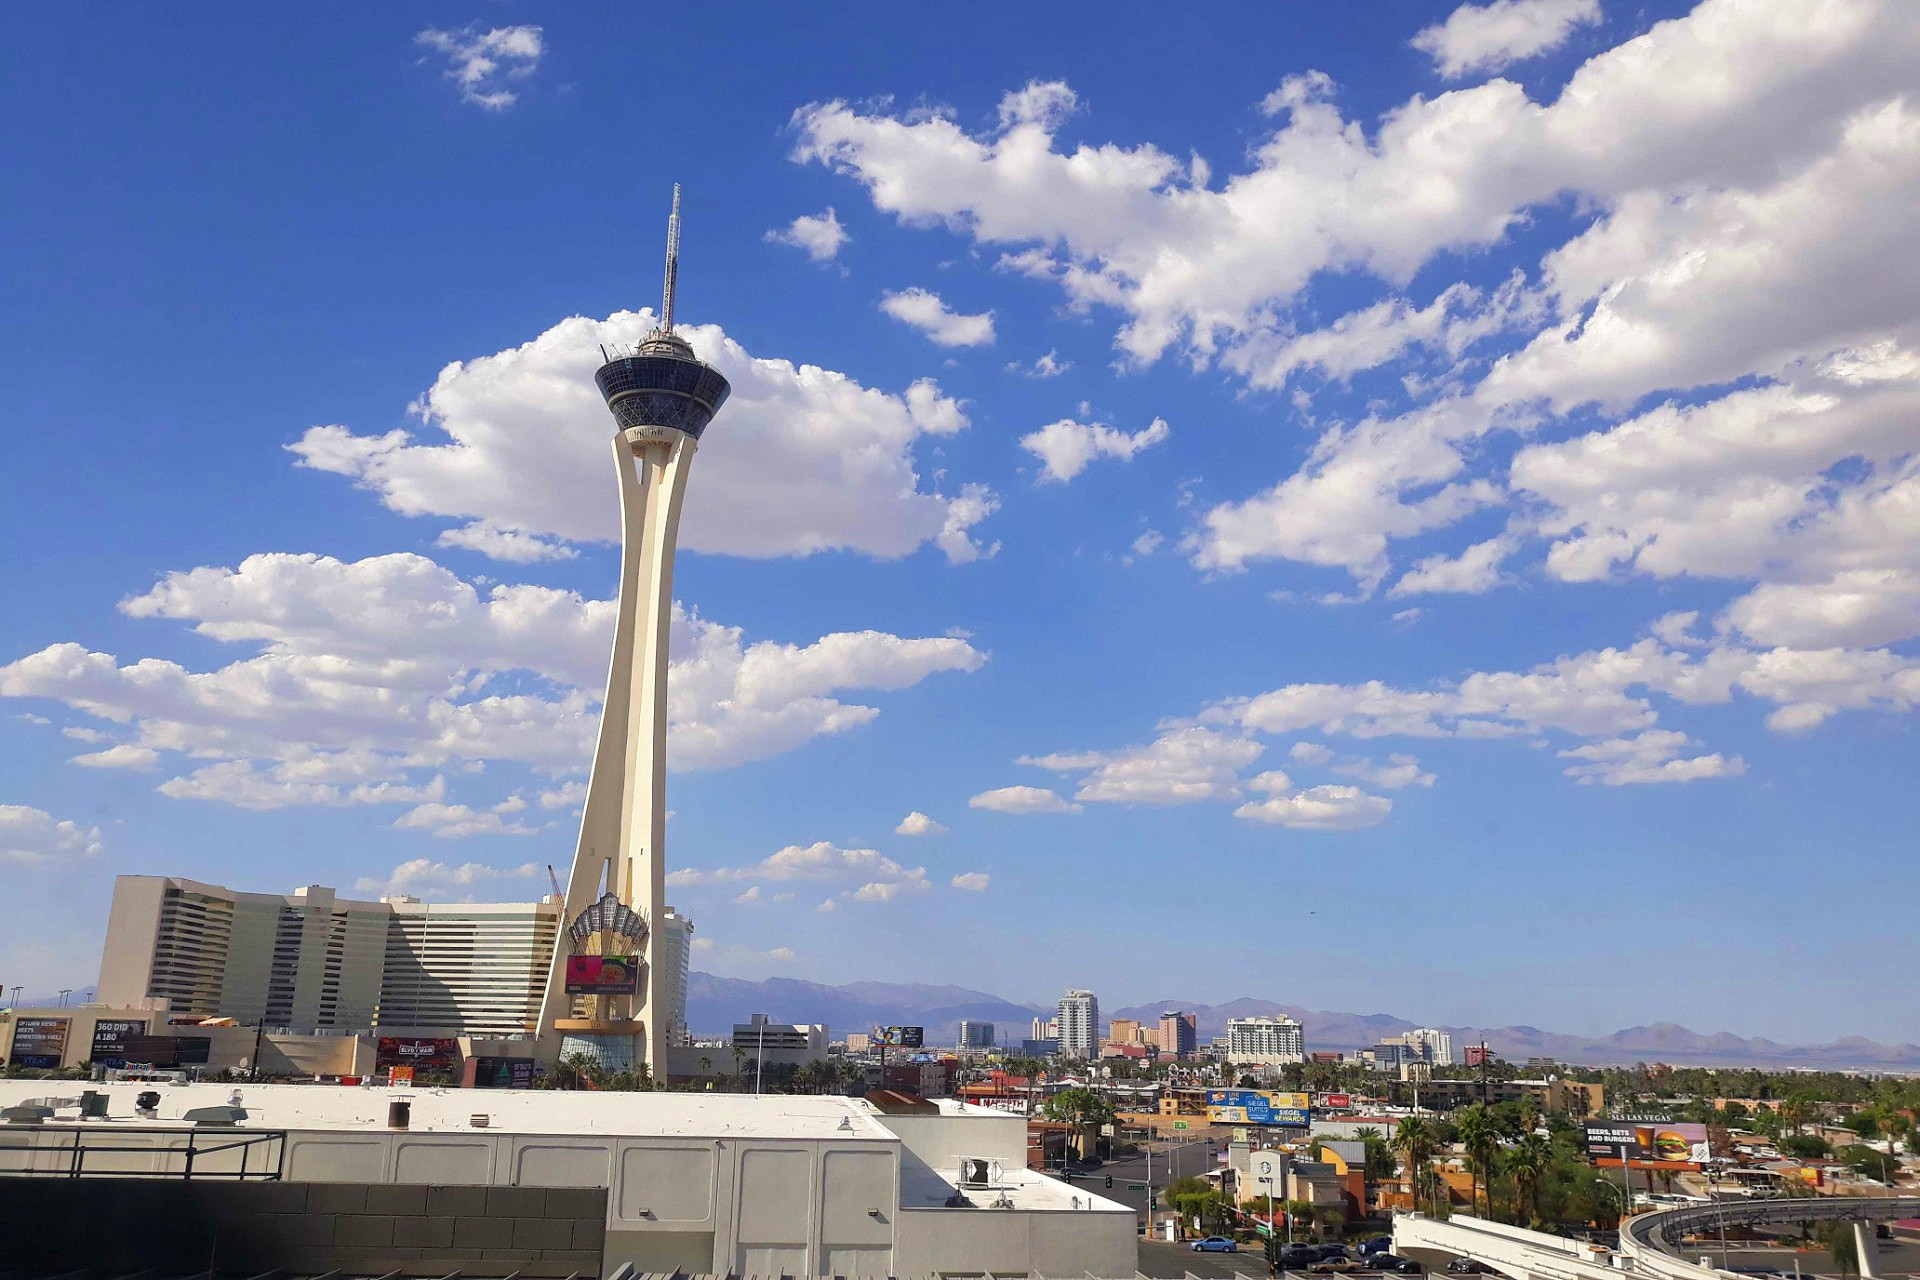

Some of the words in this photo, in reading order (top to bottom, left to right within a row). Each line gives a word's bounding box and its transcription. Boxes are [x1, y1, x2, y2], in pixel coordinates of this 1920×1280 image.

[97, 1023, 113, 1031] 360
[113, 1023, 128, 1031] DID
[95, 1033, 102, 1041] A
[102, 1033, 117, 1041] 180
[1643, 1114, 1672, 1122] VEGAS
[1587, 1128, 1611, 1136] BEERS,
